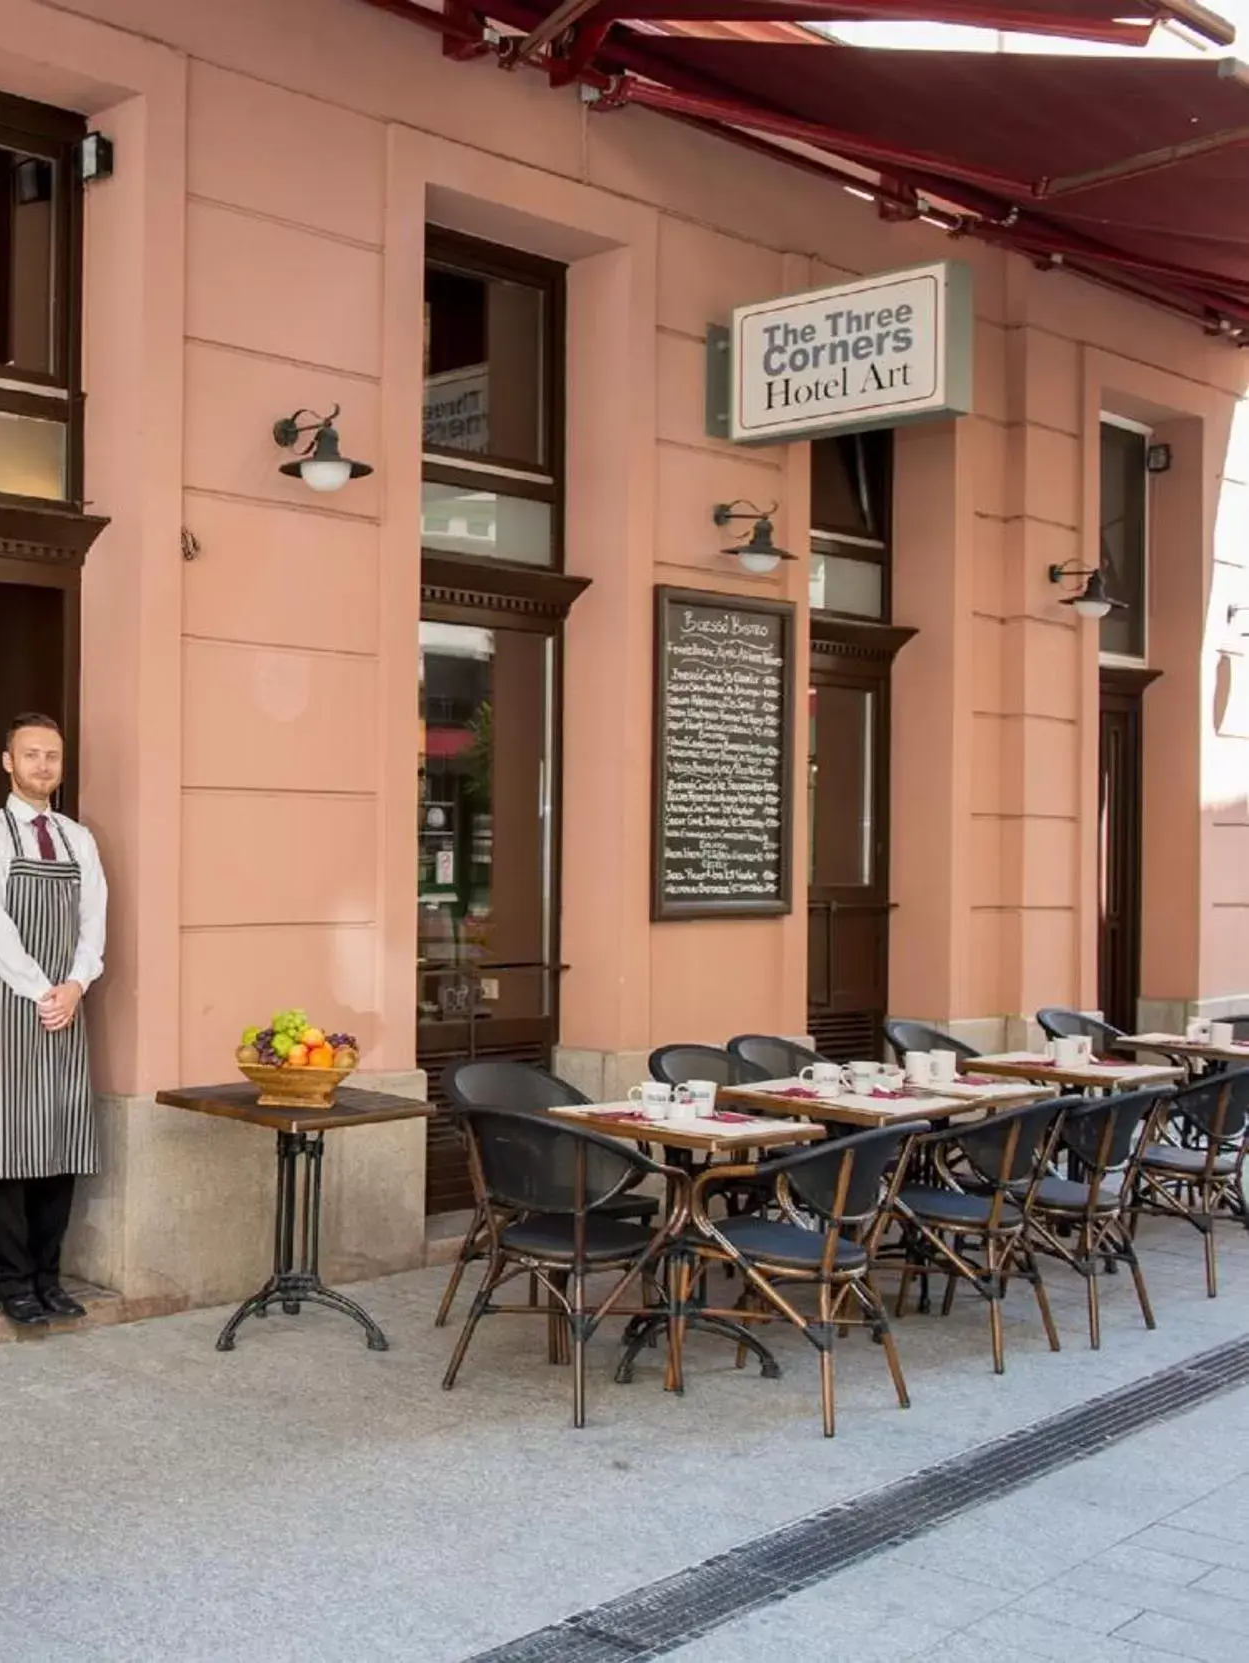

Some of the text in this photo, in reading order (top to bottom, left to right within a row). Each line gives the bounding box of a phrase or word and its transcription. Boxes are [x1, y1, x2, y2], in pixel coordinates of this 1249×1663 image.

[763, 304, 913, 348] The Three
[763, 327, 912, 377] Corners
[764, 361, 913, 411] Hotel Art
